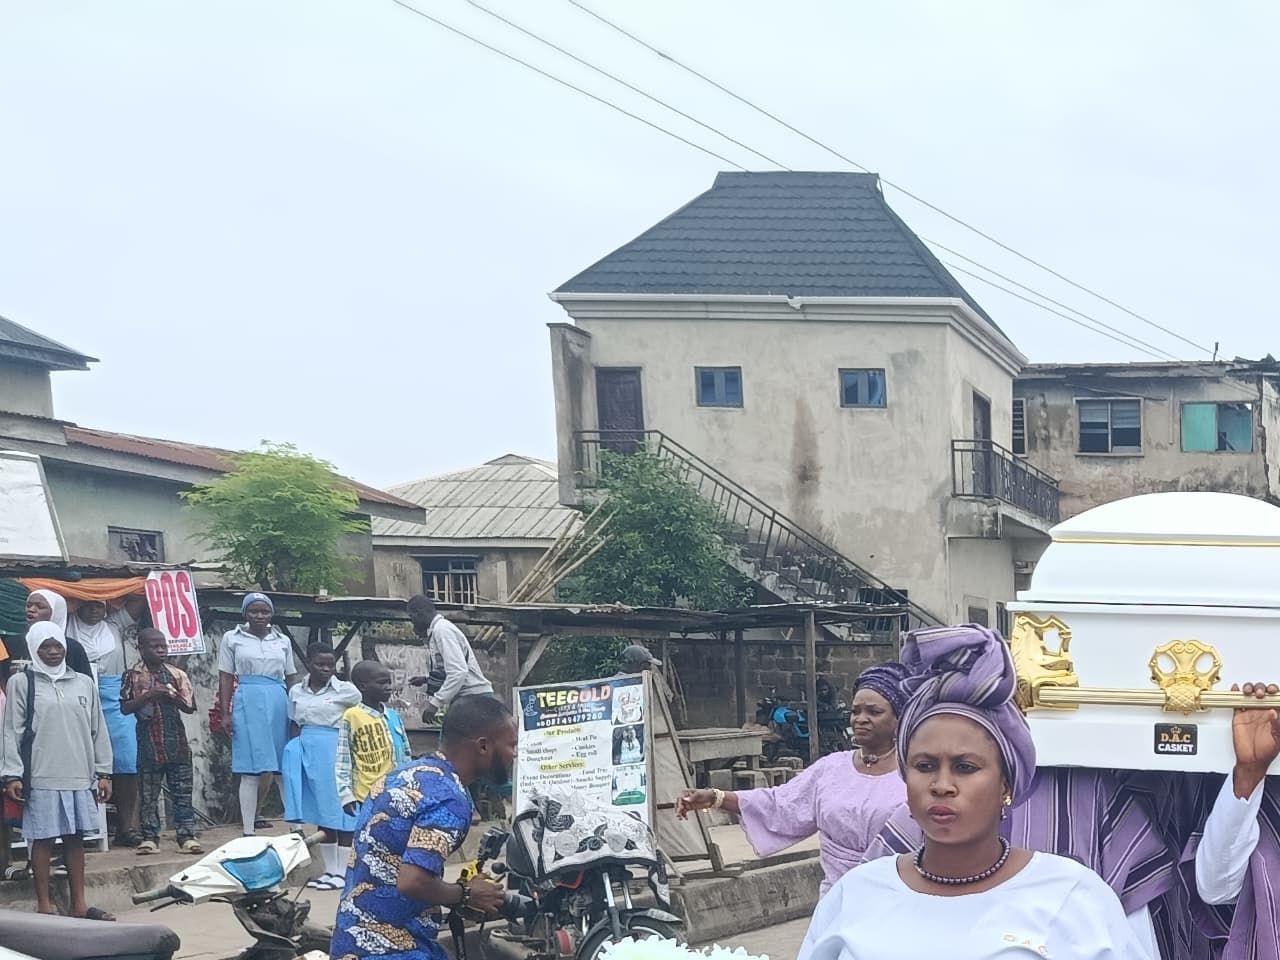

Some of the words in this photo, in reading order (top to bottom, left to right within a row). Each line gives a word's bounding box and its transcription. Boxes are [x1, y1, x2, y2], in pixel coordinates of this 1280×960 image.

[147, 572, 198, 638] POS
[536, 686, 611, 708] TEEGOLD
[1160, 733, 1191, 743] D.A.C
[1157, 744, 1194, 753] CASKET
